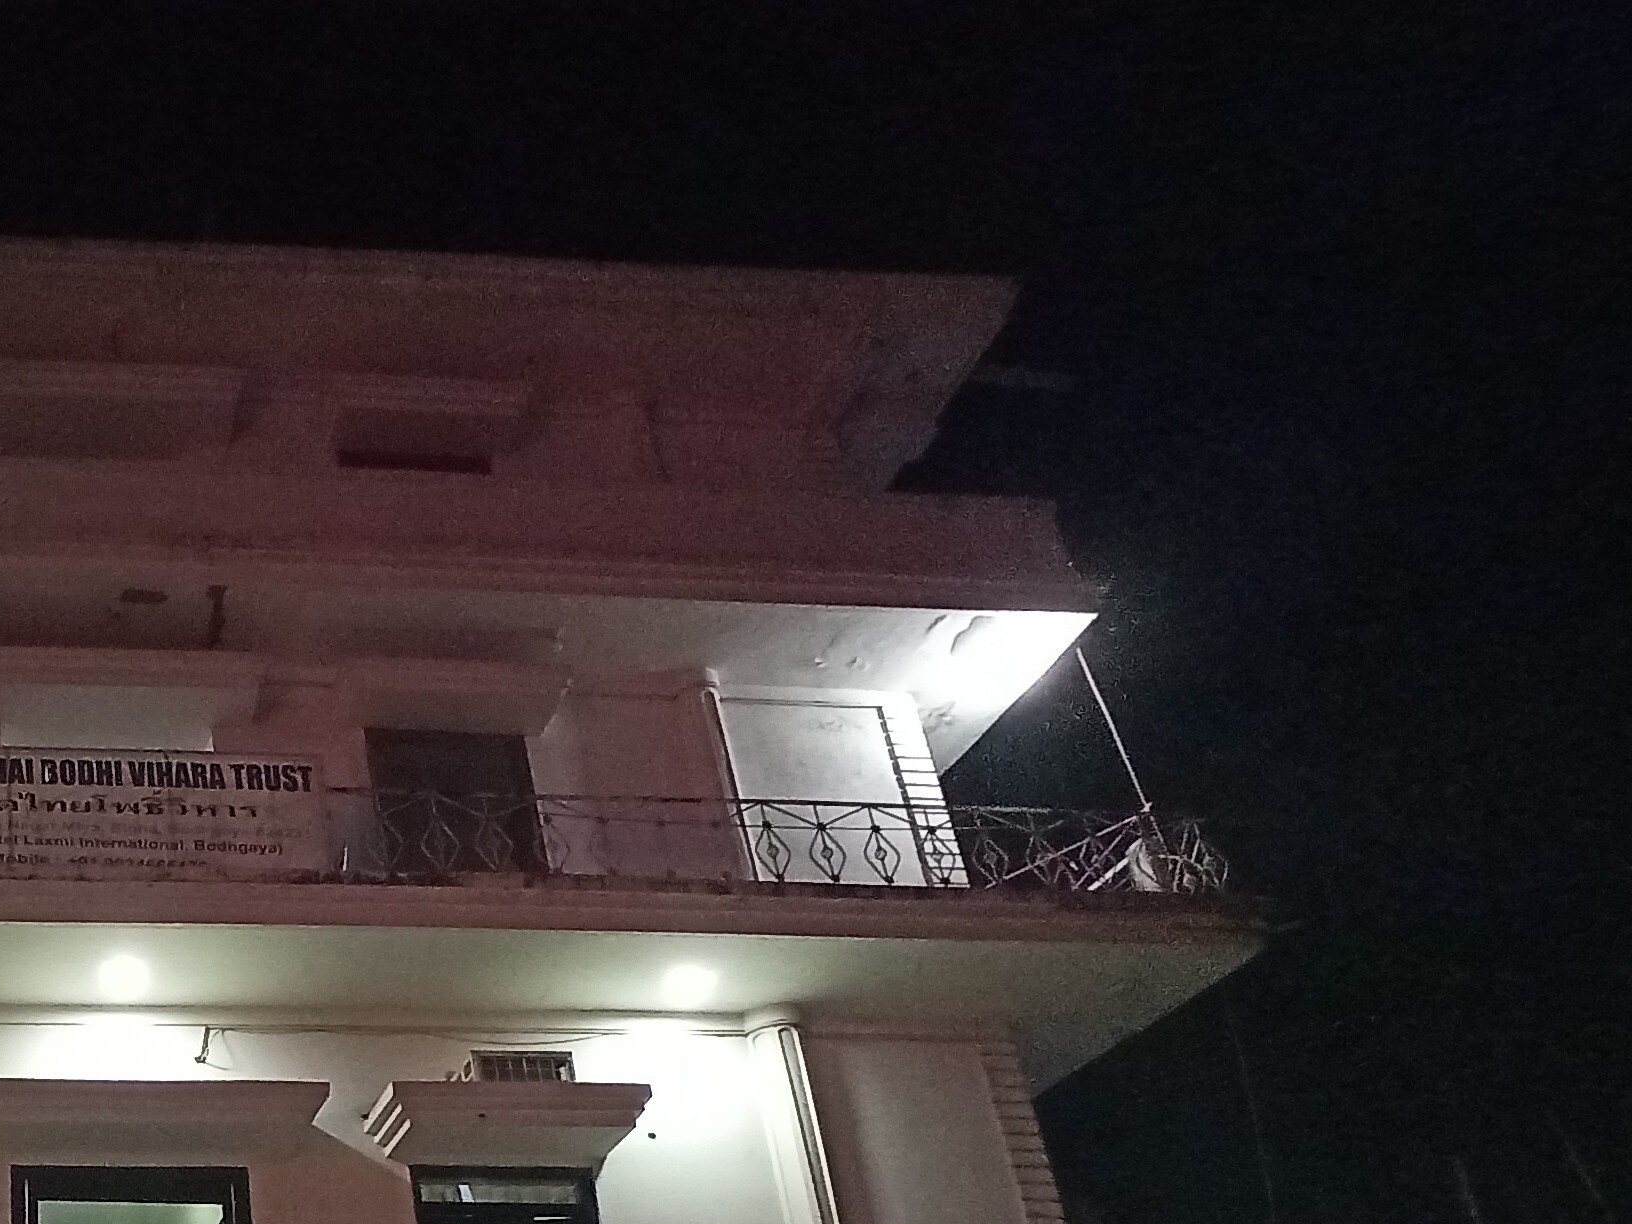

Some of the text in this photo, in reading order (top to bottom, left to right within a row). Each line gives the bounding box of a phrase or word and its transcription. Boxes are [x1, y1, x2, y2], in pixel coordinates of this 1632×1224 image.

[39, 758, 124, 787] BODHI
[127, 761, 227, 790] VIHARA
[228, 763, 313, 793] TRUST
[23, 834, 74, 848] Laxmi
